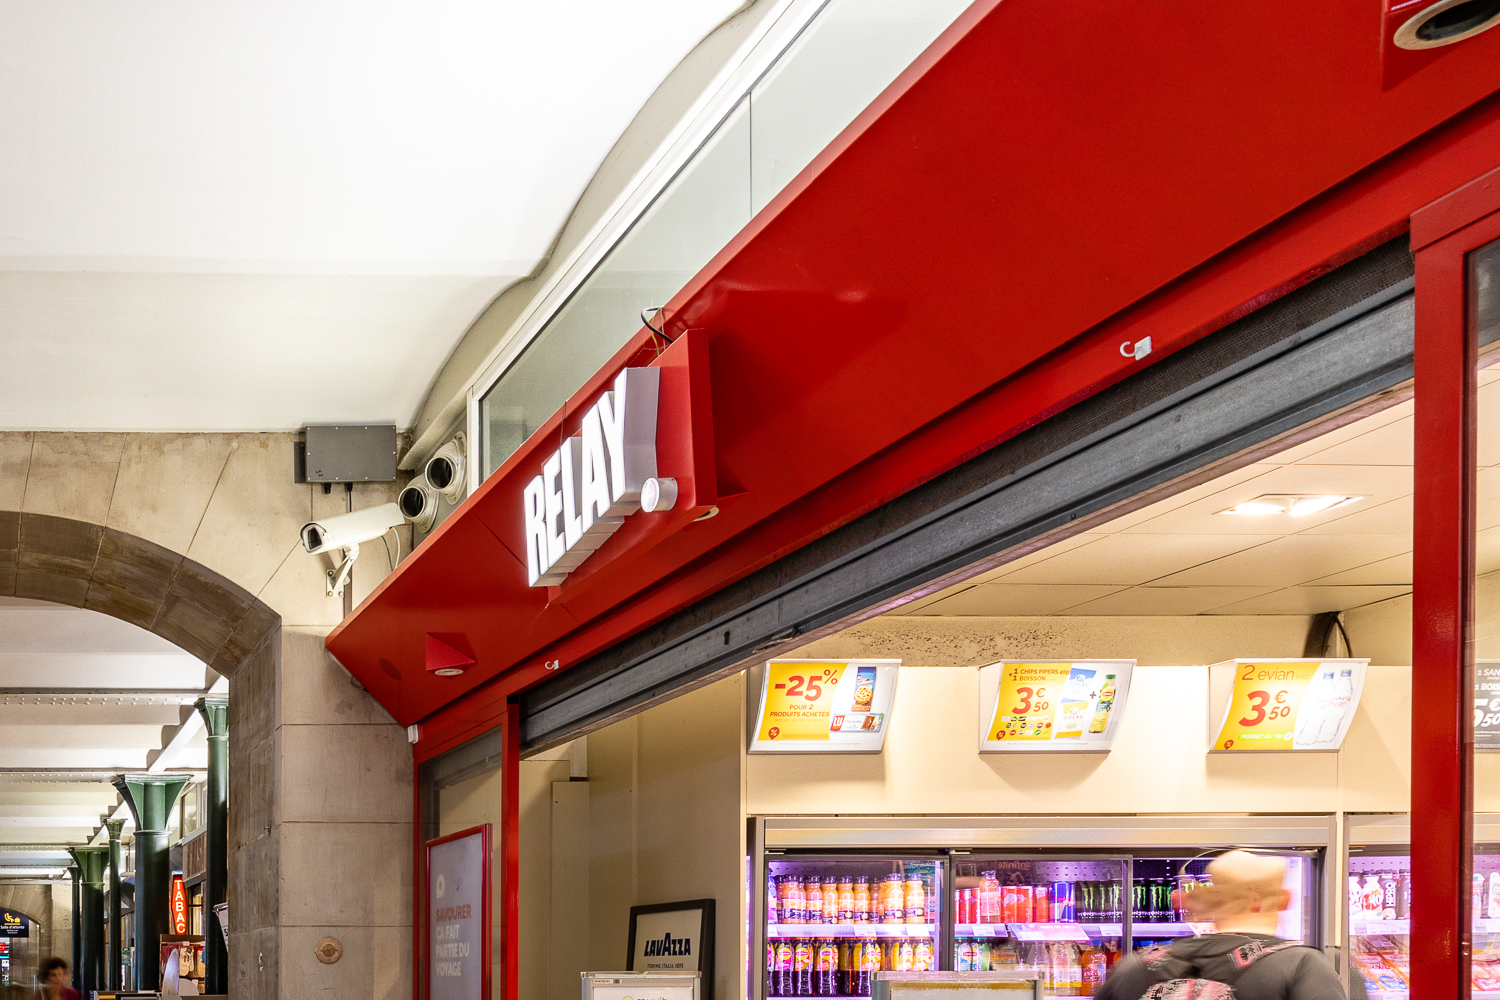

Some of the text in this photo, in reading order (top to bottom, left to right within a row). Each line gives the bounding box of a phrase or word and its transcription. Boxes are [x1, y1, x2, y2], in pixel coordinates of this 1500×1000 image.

[524, 367, 627, 587] RELAY
[1242, 664, 1255, 680] 2
[1258, 668, 1294, 680] evian
[775, 669, 838, 701] -25%
[833, 716, 844, 727] LU
[1386, 882, 1394, 907] HIPRO
[174, 879, 186, 934] TABAC
[436, 904, 472, 922] SAVOURER
[436, 924, 460, 942] ÇA FAIT
[436, 942, 470, 959] PARTIE DU
[644, 932, 691, 957] LAVAZZA
[436, 962, 462, 976] VOYAGE
